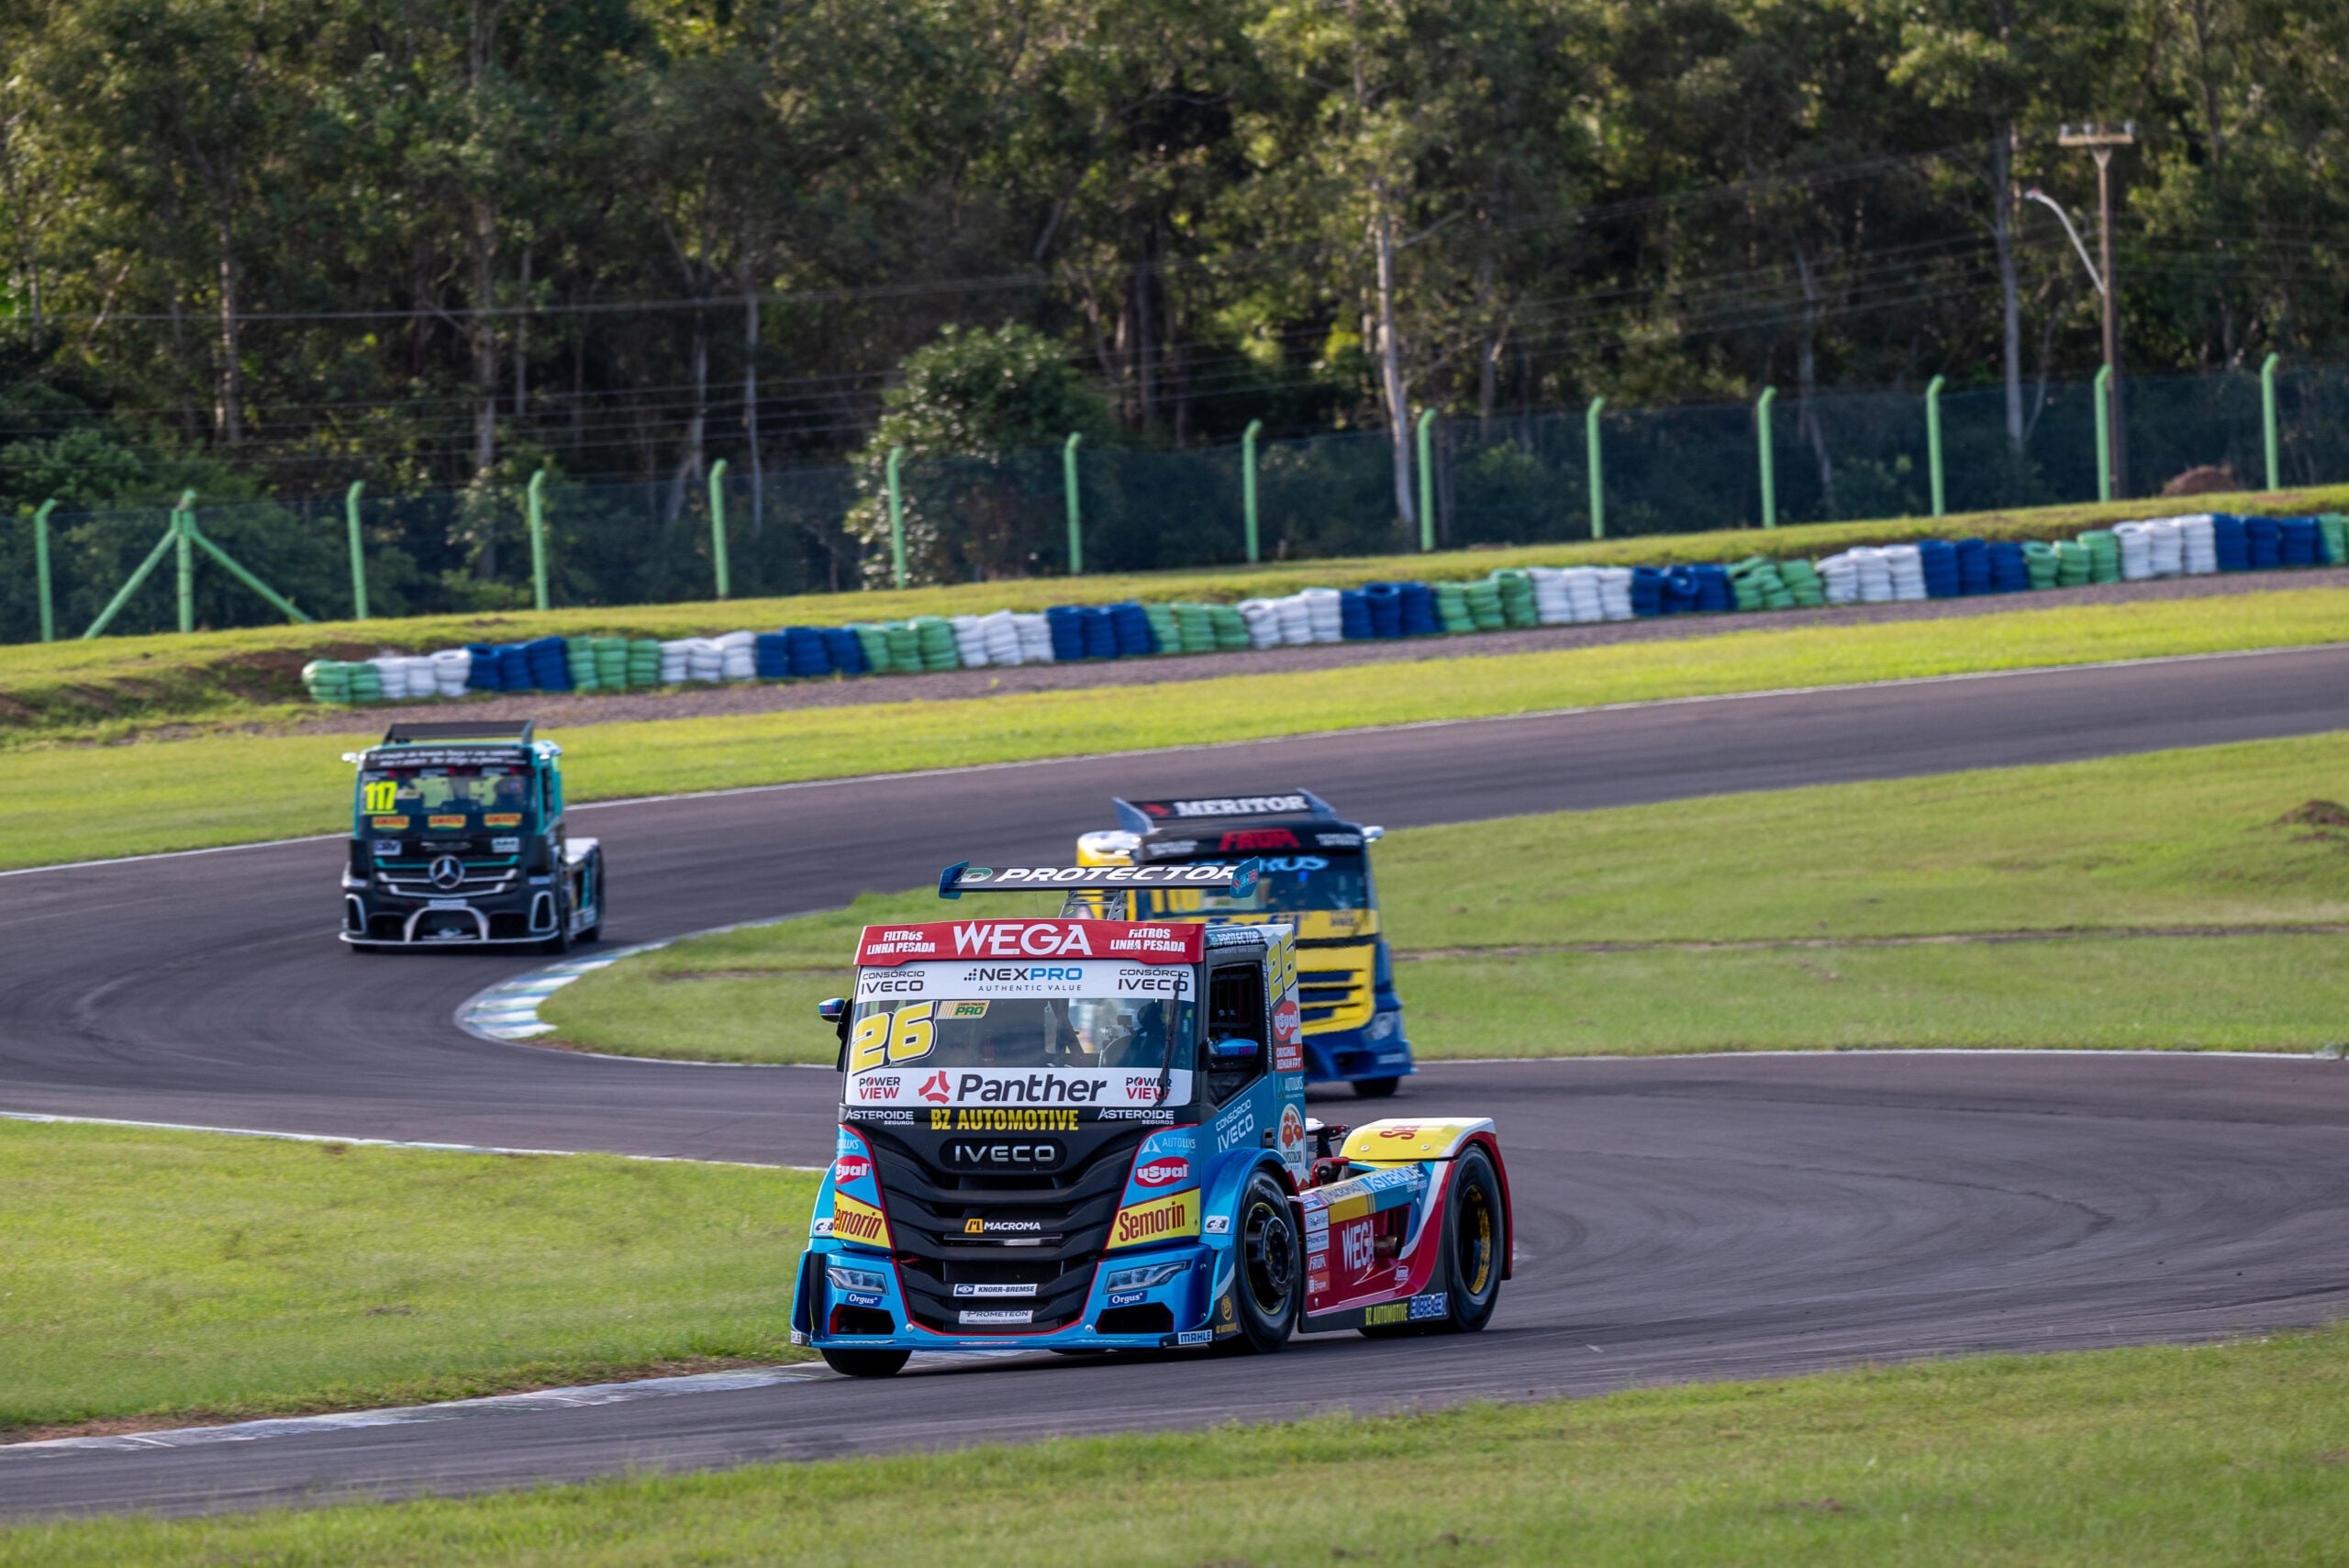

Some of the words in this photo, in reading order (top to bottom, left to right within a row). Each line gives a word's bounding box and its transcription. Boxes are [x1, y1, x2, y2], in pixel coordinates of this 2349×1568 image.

[363, 781, 398, 810] 117
[1174, 795, 1310, 817] MERITOR
[994, 865, 1236, 883] PROTECTOR
[883, 930, 924, 942] FILTROS
[952, 920, 1093, 956] WEGA
[1129, 928, 1171, 940] FILTROS
[866, 941, 895, 955] LINHA
[896, 942, 936, 953] PESADA
[1110, 940, 1140, 951] LINHA
[1143, 940, 1186, 952] PESADA
[863, 970, 925, 981] CONSÓRCIO
[979, 967, 1083, 982] NEXPRO
[1119, 968, 1189, 978] CONSÓRCIO
[1266, 930, 1297, 1007] 26
[861, 980, 924, 995] IVECO
[1118, 979, 1188, 992] IVECO
[954, 1006, 984, 1016] PRO
[852, 1000, 938, 1076] 26
[859, 1076, 901, 1087] POWER
[957, 1073, 1108, 1102] Panther
[859, 1086, 900, 1099] VIEW
[844, 1107, 914, 1121] ASTEROIDE
[930, 1109, 952, 1130] BZ
[956, 1109, 1079, 1131] AUTOMOTIVE
[1097, 1107, 1174, 1121] ASTEROIDE
[1216, 1099, 1252, 1131] CONSÓRCIO
[1217, 1113, 1254, 1152] IVECO
[954, 1145, 1055, 1162] IVECO
[834, 1162, 869, 1181] sual
[1137, 1163, 1189, 1184] usual
[1119, 1201, 1186, 1241] Semorin
[849, 1294, 875, 1305] Orgus
[1112, 1294, 1141, 1305] Orgus
[1181, 1331, 1212, 1343] MAHLE
